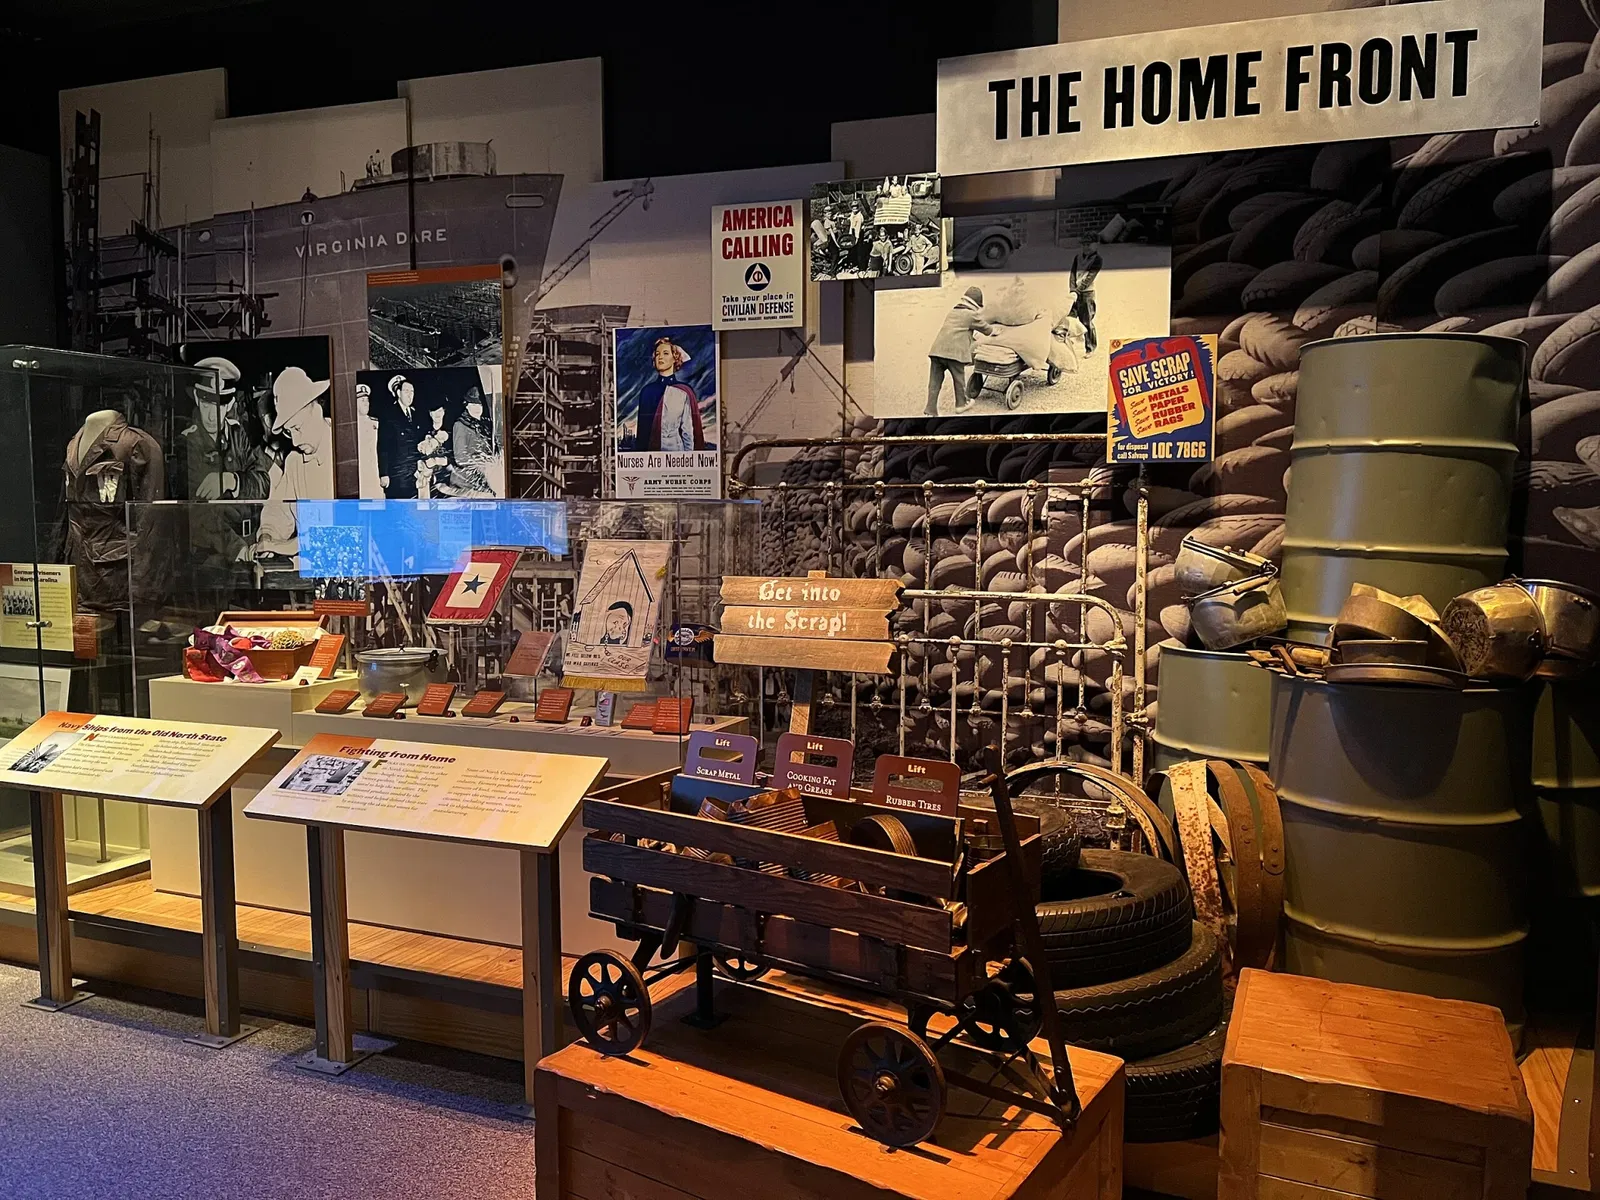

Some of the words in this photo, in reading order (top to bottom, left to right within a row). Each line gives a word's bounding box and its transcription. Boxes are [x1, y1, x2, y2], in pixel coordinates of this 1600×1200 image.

[988, 71, 1082, 141] THE
[1102, 50, 1263, 130] HOME
[1284, 29, 1479, 112] FRONT
[722, 205, 794, 232] AMERICA
[295, 233, 388, 258] VIRGINIA
[396, 229, 448, 245] DARE
[722, 233, 794, 260] CALLING
[722, 295, 739, 303] Take
[743, 294, 760, 303] your
[763, 293, 783, 302] place
[722, 303, 756, 317] CIVILIAN
[759, 301, 794, 315] DEFENSE
[1119, 363, 1150, 389] SAVE
[1151, 352, 1191, 380] SCRAP
[1122, 385, 1142, 397] FOR
[1147, 370, 1195, 389] VICTORY!
[1130, 398, 1146, 410] Save
[1148, 385, 1189, 404] METALS
[1132, 406, 1148, 418] Save
[1150, 395, 1185, 412] PAPER
[1134, 415, 1150, 427] Save
[1152, 402, 1196, 420] RUBBER
[1137, 423, 1153, 435] Save
[1154, 414, 1184, 428] RAGS
[1117, 443, 1125, 451] for
[1125, 442, 1149, 452] disposal
[1117, 452, 1127, 460] call
[1152, 442, 1173, 459] LOC
[1176, 441, 1206, 459] 7866
[617, 454, 644, 469] Nurses
[647, 453, 662, 468] Are
[665, 453, 694, 468] Needed
[697, 452, 718, 468] Now!
[758, 579, 793, 601] Get
[801, 582, 841, 601] into
[748, 610, 776, 629] the
[784, 609, 847, 637] Scrap!
[607, 656, 630, 669] CLASS
[617, 654, 632, 664] OUR
[57, 721, 82, 731] Navy
[82, 723, 110, 734] Ships
[109, 725, 133, 735] from
[134, 728, 151, 736] the
[152, 728, 171, 738] Old
[170, 731, 199, 741] North
[199, 734, 228, 743] State
[715, 738, 730, 747] Lift
[806, 741, 824, 751] Lift
[338, 745, 389, 761] Fighting
[388, 748, 421, 761] from
[420, 752, 457, 764] Home
[696, 766, 717, 777] SCRAP
[717, 769, 741, 781] METAL
[907, 764, 926, 774] Lift
[786, 770, 821, 784] COOKING
[821, 775, 837, 787] FAT
[804, 783, 833, 796] GREASE
[885, 795, 916, 808] RUBBER
[917, 799, 942, 812] TIRES
